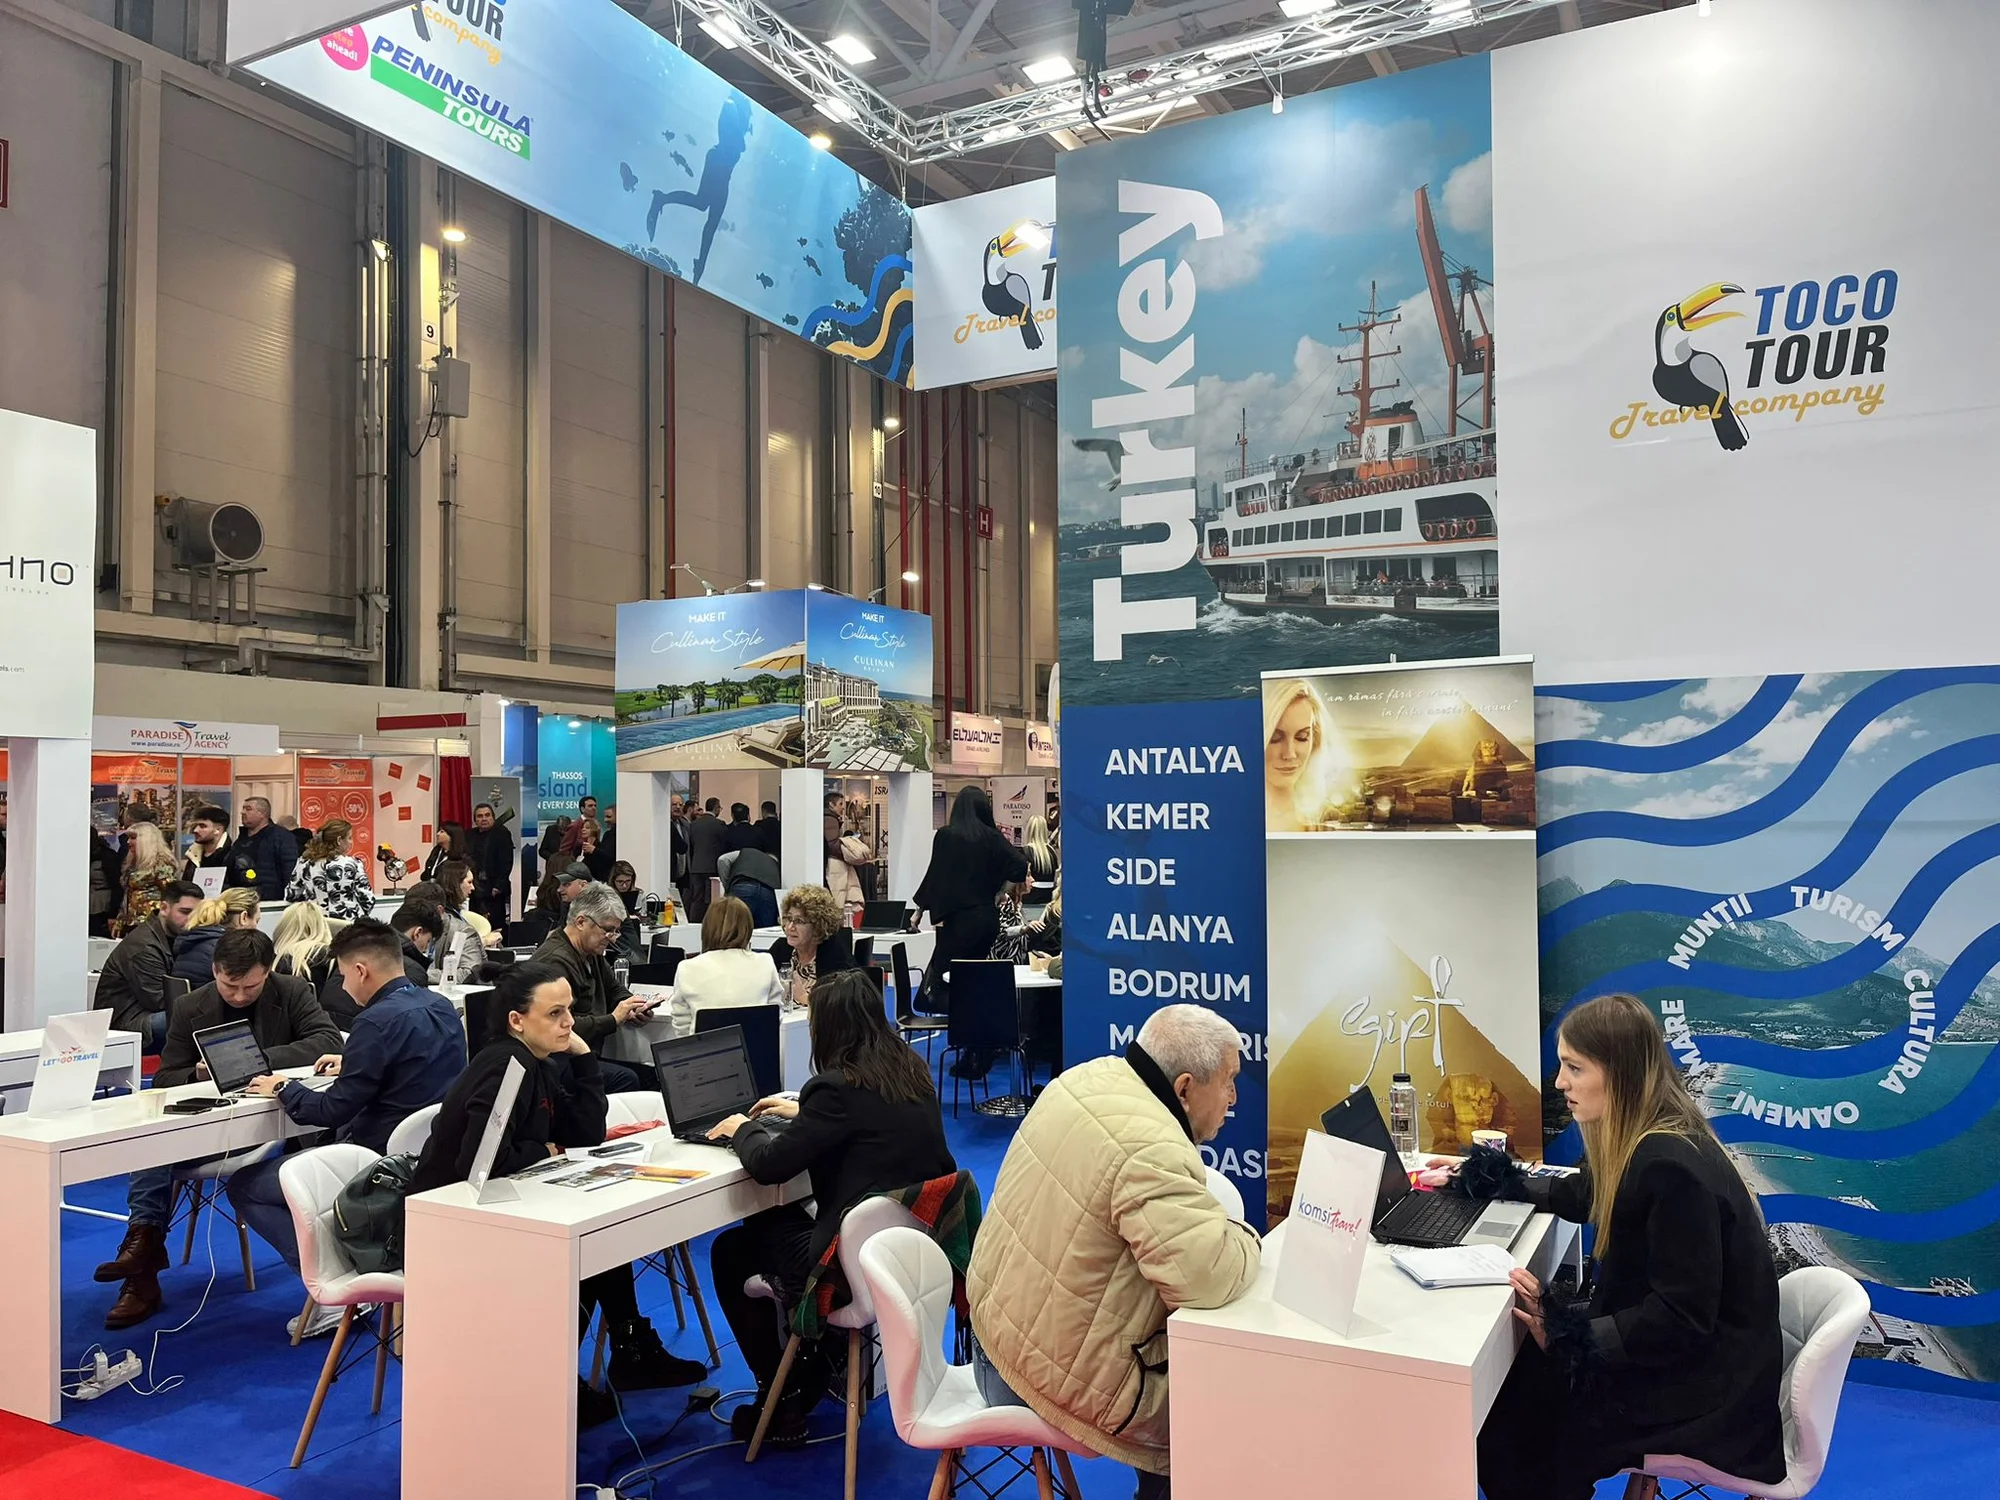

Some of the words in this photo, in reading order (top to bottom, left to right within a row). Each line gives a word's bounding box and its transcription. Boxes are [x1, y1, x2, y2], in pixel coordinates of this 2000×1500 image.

[424, 6, 501, 67] company
[371, 35, 532, 137] PENINSULA
[441, 96, 523, 153] TOURS
[1754, 269, 1899, 336] TOCO
[426, 325, 435, 339] 9
[953, 304, 1029, 345] Travel
[1745, 324, 1890, 389] TOUR
[1092, 180, 1224, 661] Turkey
[1609, 391, 1727, 440] Travel
[1733, 383, 1886, 423] company
[688, 612, 717, 624] MAKE
[717, 611, 727, 621] IT
[861, 612, 878, 623] MAKE
[878, 615, 885, 624] IT
[651, 630, 717, 654] Cullinan
[710, 628, 766, 659] Style
[840, 622, 881, 642] Cullinan
[874, 631, 907, 657] Style
[853, 654, 895, 669] CULLINAN
[130, 729, 185, 741] PARADISE
[194, 731, 231, 741] Travel
[194, 740, 230, 749] AGENCY
[551, 771, 584, 780] THASSOS
[1104, 745, 1246, 776] ANTALYA
[542, 800, 565, 810] EVERY
[1106, 802, 1211, 831] KEMER
[1106, 857, 1177, 886] SIDE
[1107, 913, 1235, 945] ALANYA
[1790, 885, 1906, 952] TURISM
[1108, 967, 1251, 1003] BODRUM
[1660, 999, 1709, 1076] MARE
[1877, 969, 1936, 1095] CULTURA
[1730, 1090, 1860, 1130] OAMENI
